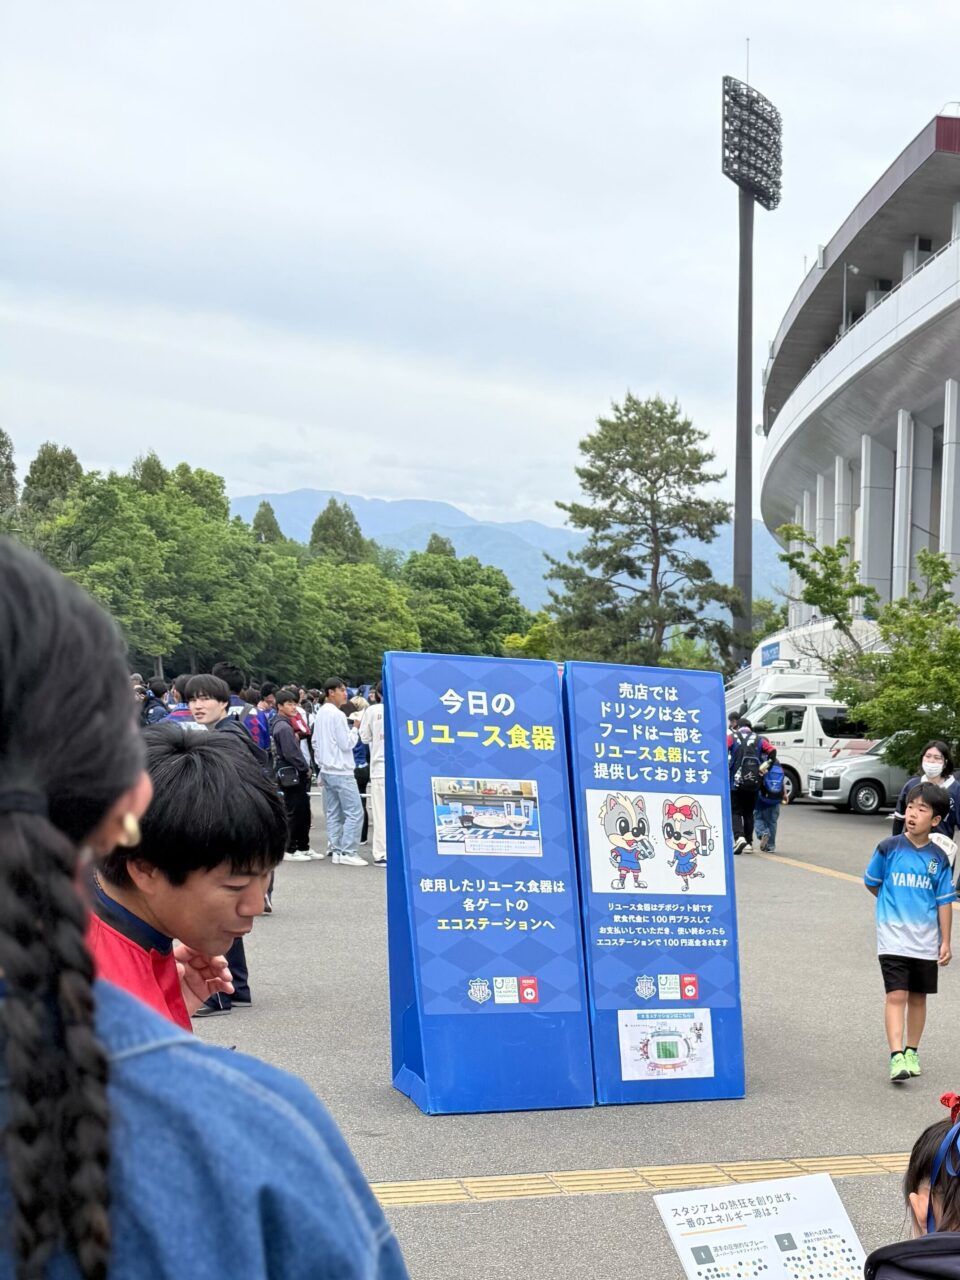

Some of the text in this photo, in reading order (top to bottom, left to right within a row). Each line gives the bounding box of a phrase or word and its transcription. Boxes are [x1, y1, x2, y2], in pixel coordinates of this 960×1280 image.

[439, 688, 515, 716] 今日の
[619, 683, 678, 701] 売店では
[600, 702, 701, 723] ドリンクは全て
[406, 719, 556, 750] リユース食器
[600, 723, 703, 743] フードは一部を
[594, 743, 710, 763] リユース食器にて
[594, 763, 712, 784] 提供しております
[420, 878, 565, 893] 使用したリユース食器は
[463, 898, 529, 911] 各ゲートの
[608, 903, 713, 912] リユース食器はデポジット制です
[437, 917, 556, 931] エコステーションへ
[676, 1206, 779, 1228] 一番のエネルギー源は？
